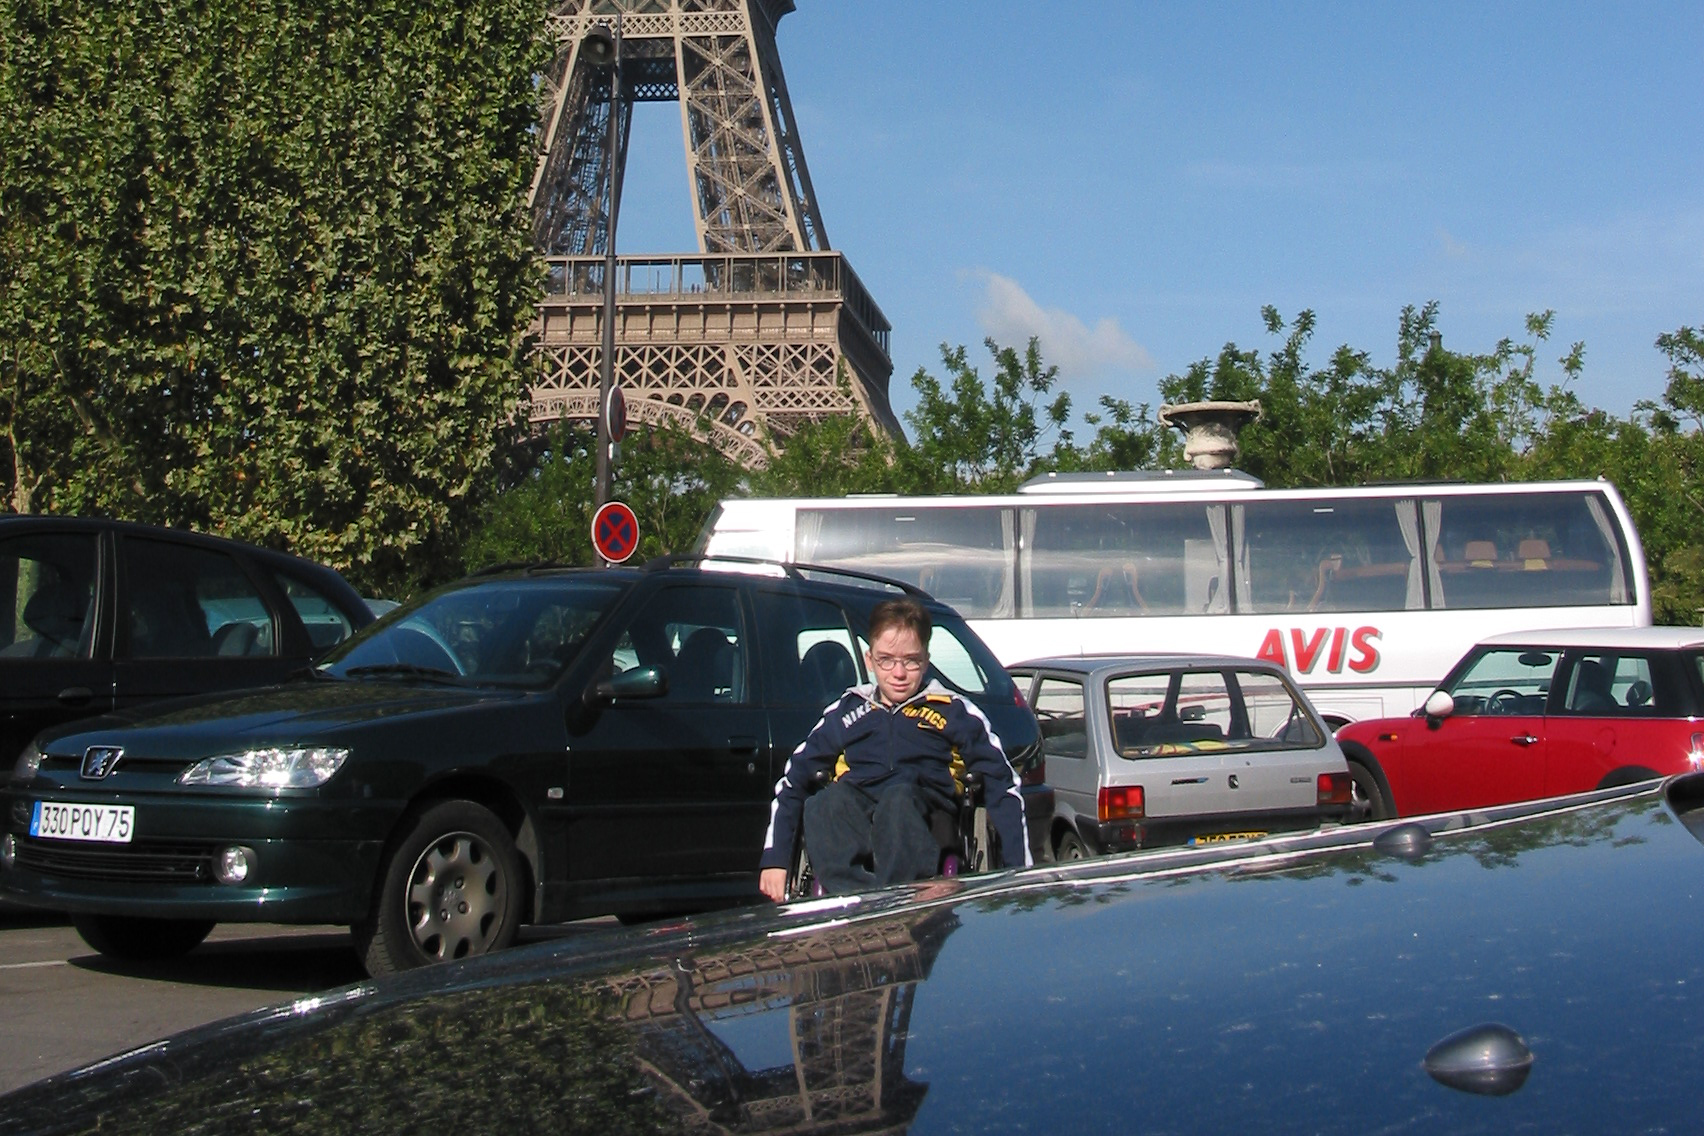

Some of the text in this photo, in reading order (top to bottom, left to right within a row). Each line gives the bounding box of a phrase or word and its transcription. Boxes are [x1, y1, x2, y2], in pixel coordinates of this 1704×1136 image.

[1256, 626, 1383, 674] AVIS
[842, 701, 872, 728] NIKE
[42, 806, 68, 834] 330
[107, 810, 130, 837] 75
